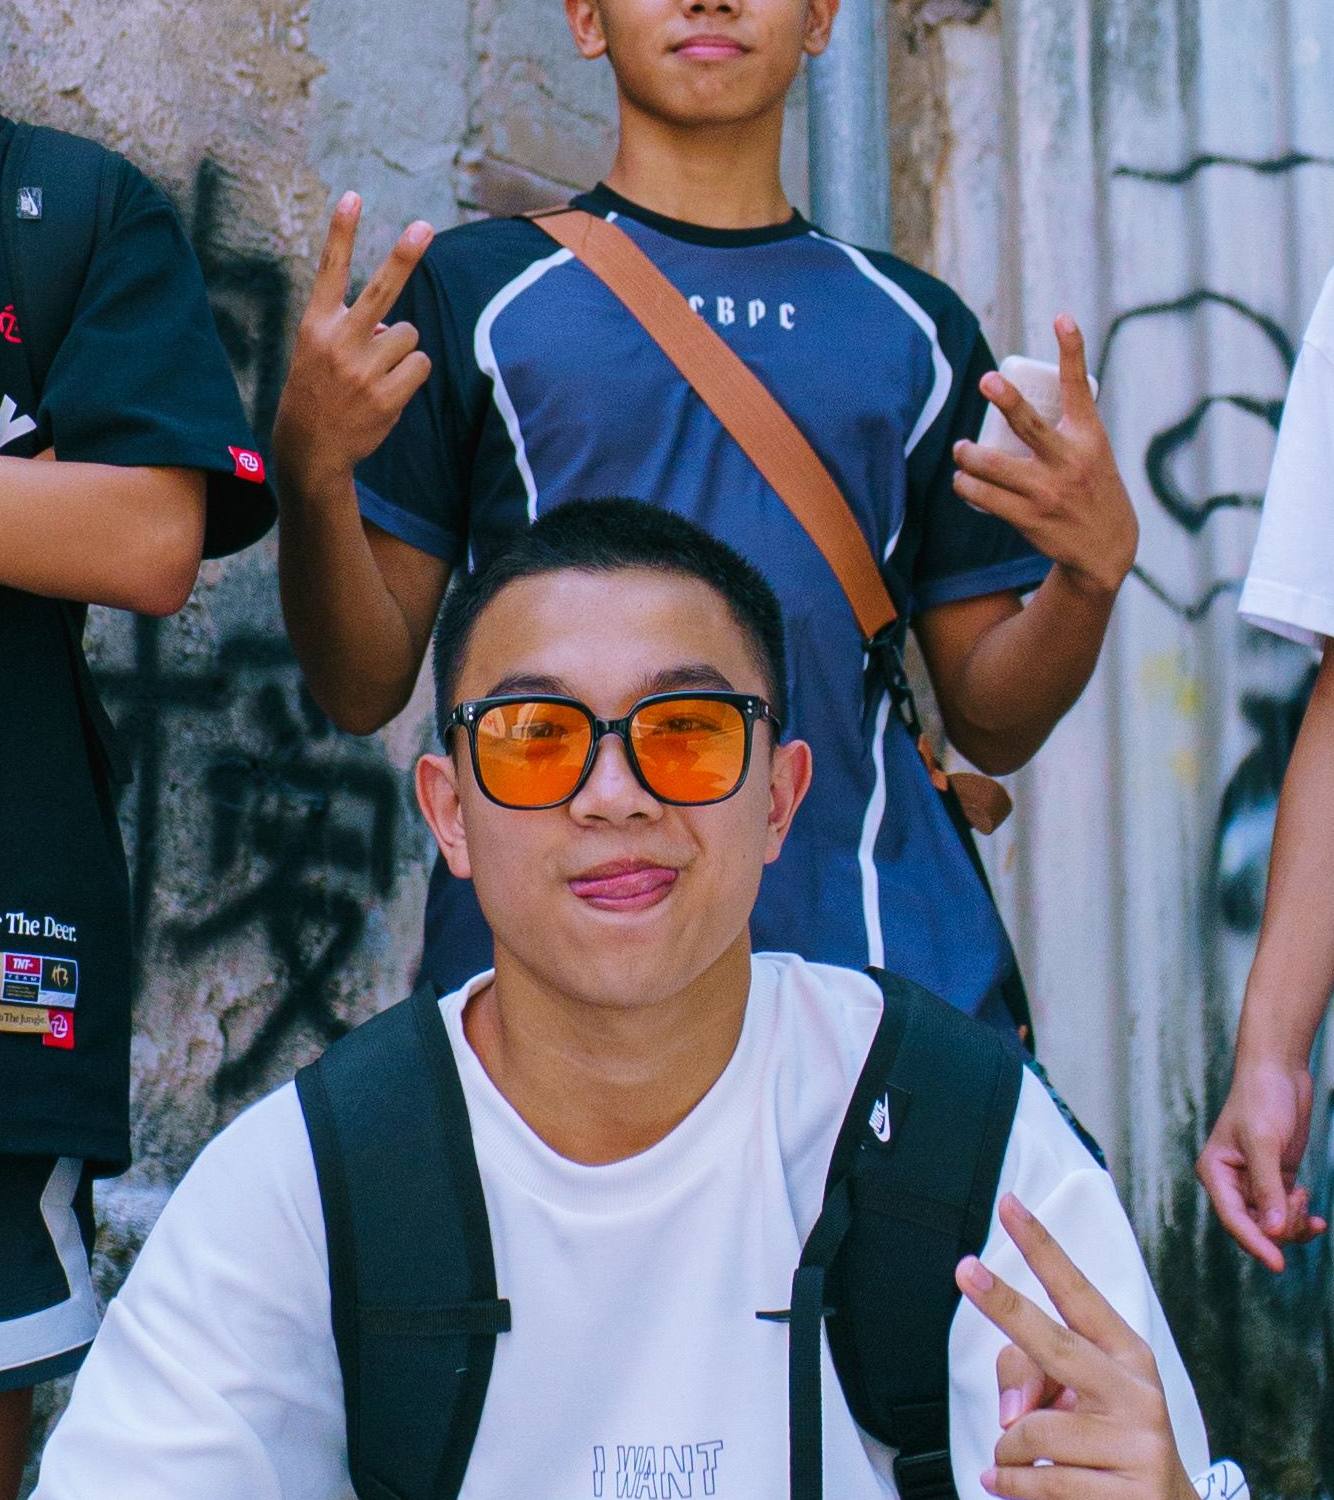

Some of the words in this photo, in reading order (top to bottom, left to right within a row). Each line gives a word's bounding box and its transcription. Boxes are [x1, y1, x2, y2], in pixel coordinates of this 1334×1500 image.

[6, 911, 41, 936] The
[43, 915, 77, 942] Deer.
[5, 1012, 20, 1023] The
[592, 1445, 606, 1498] I
[616, 1439, 724, 1500] WANT
